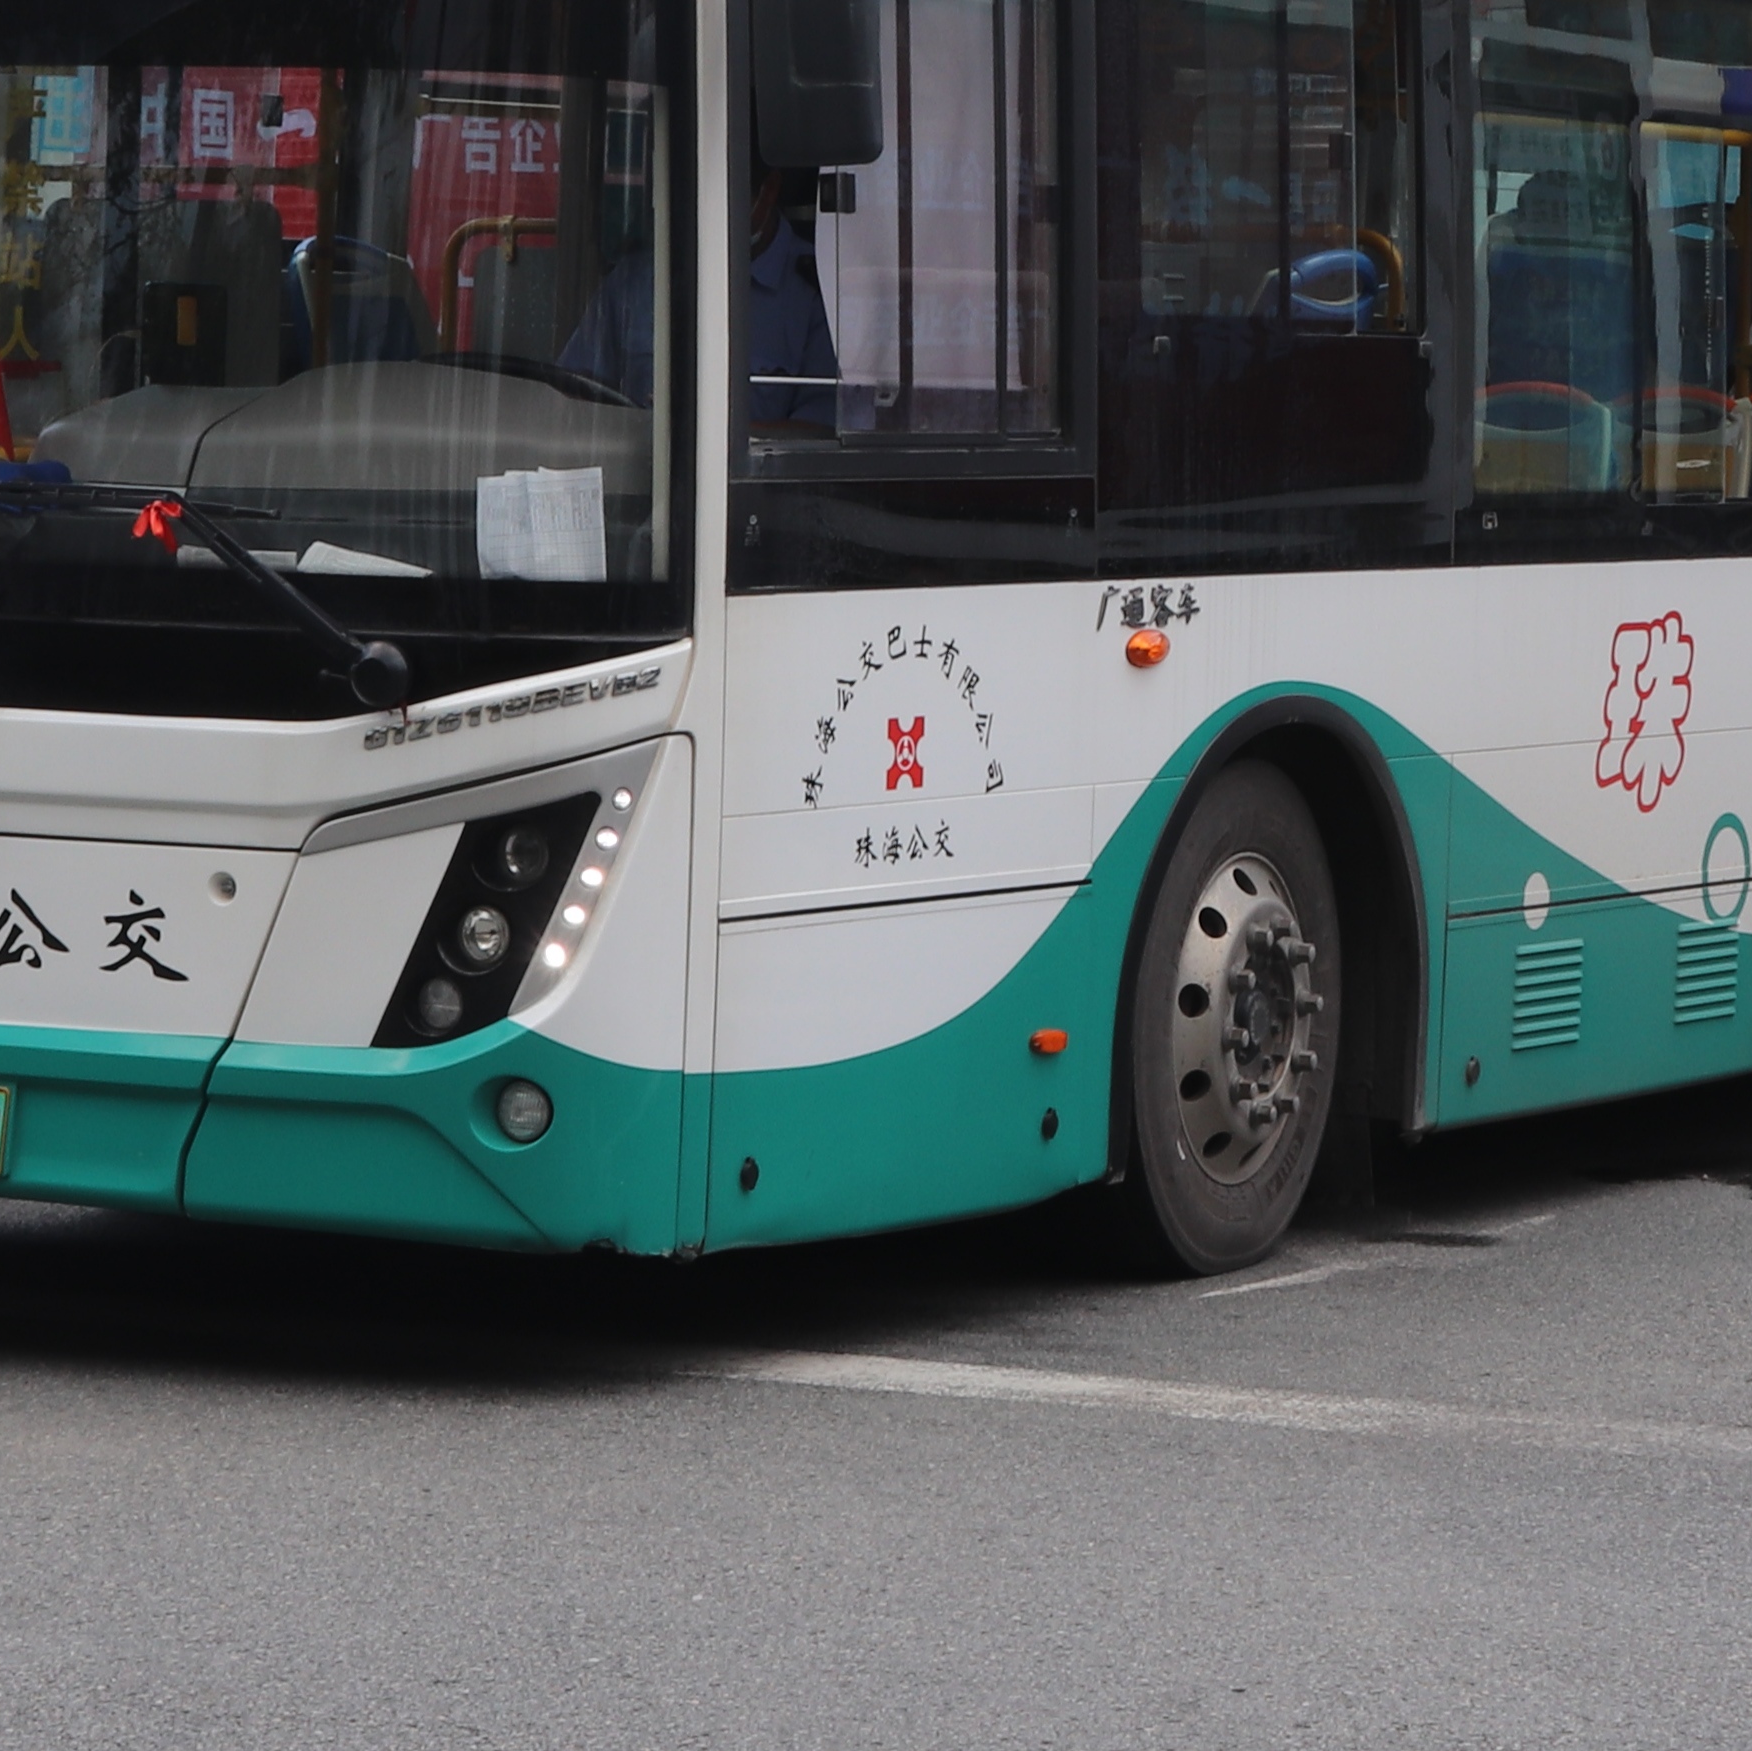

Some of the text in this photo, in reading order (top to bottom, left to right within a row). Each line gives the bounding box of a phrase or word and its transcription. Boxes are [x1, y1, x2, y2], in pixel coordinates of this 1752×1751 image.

[1096, 584, 1201, 632] 广通客车
[854, 819, 954, 868] 珠海公交
